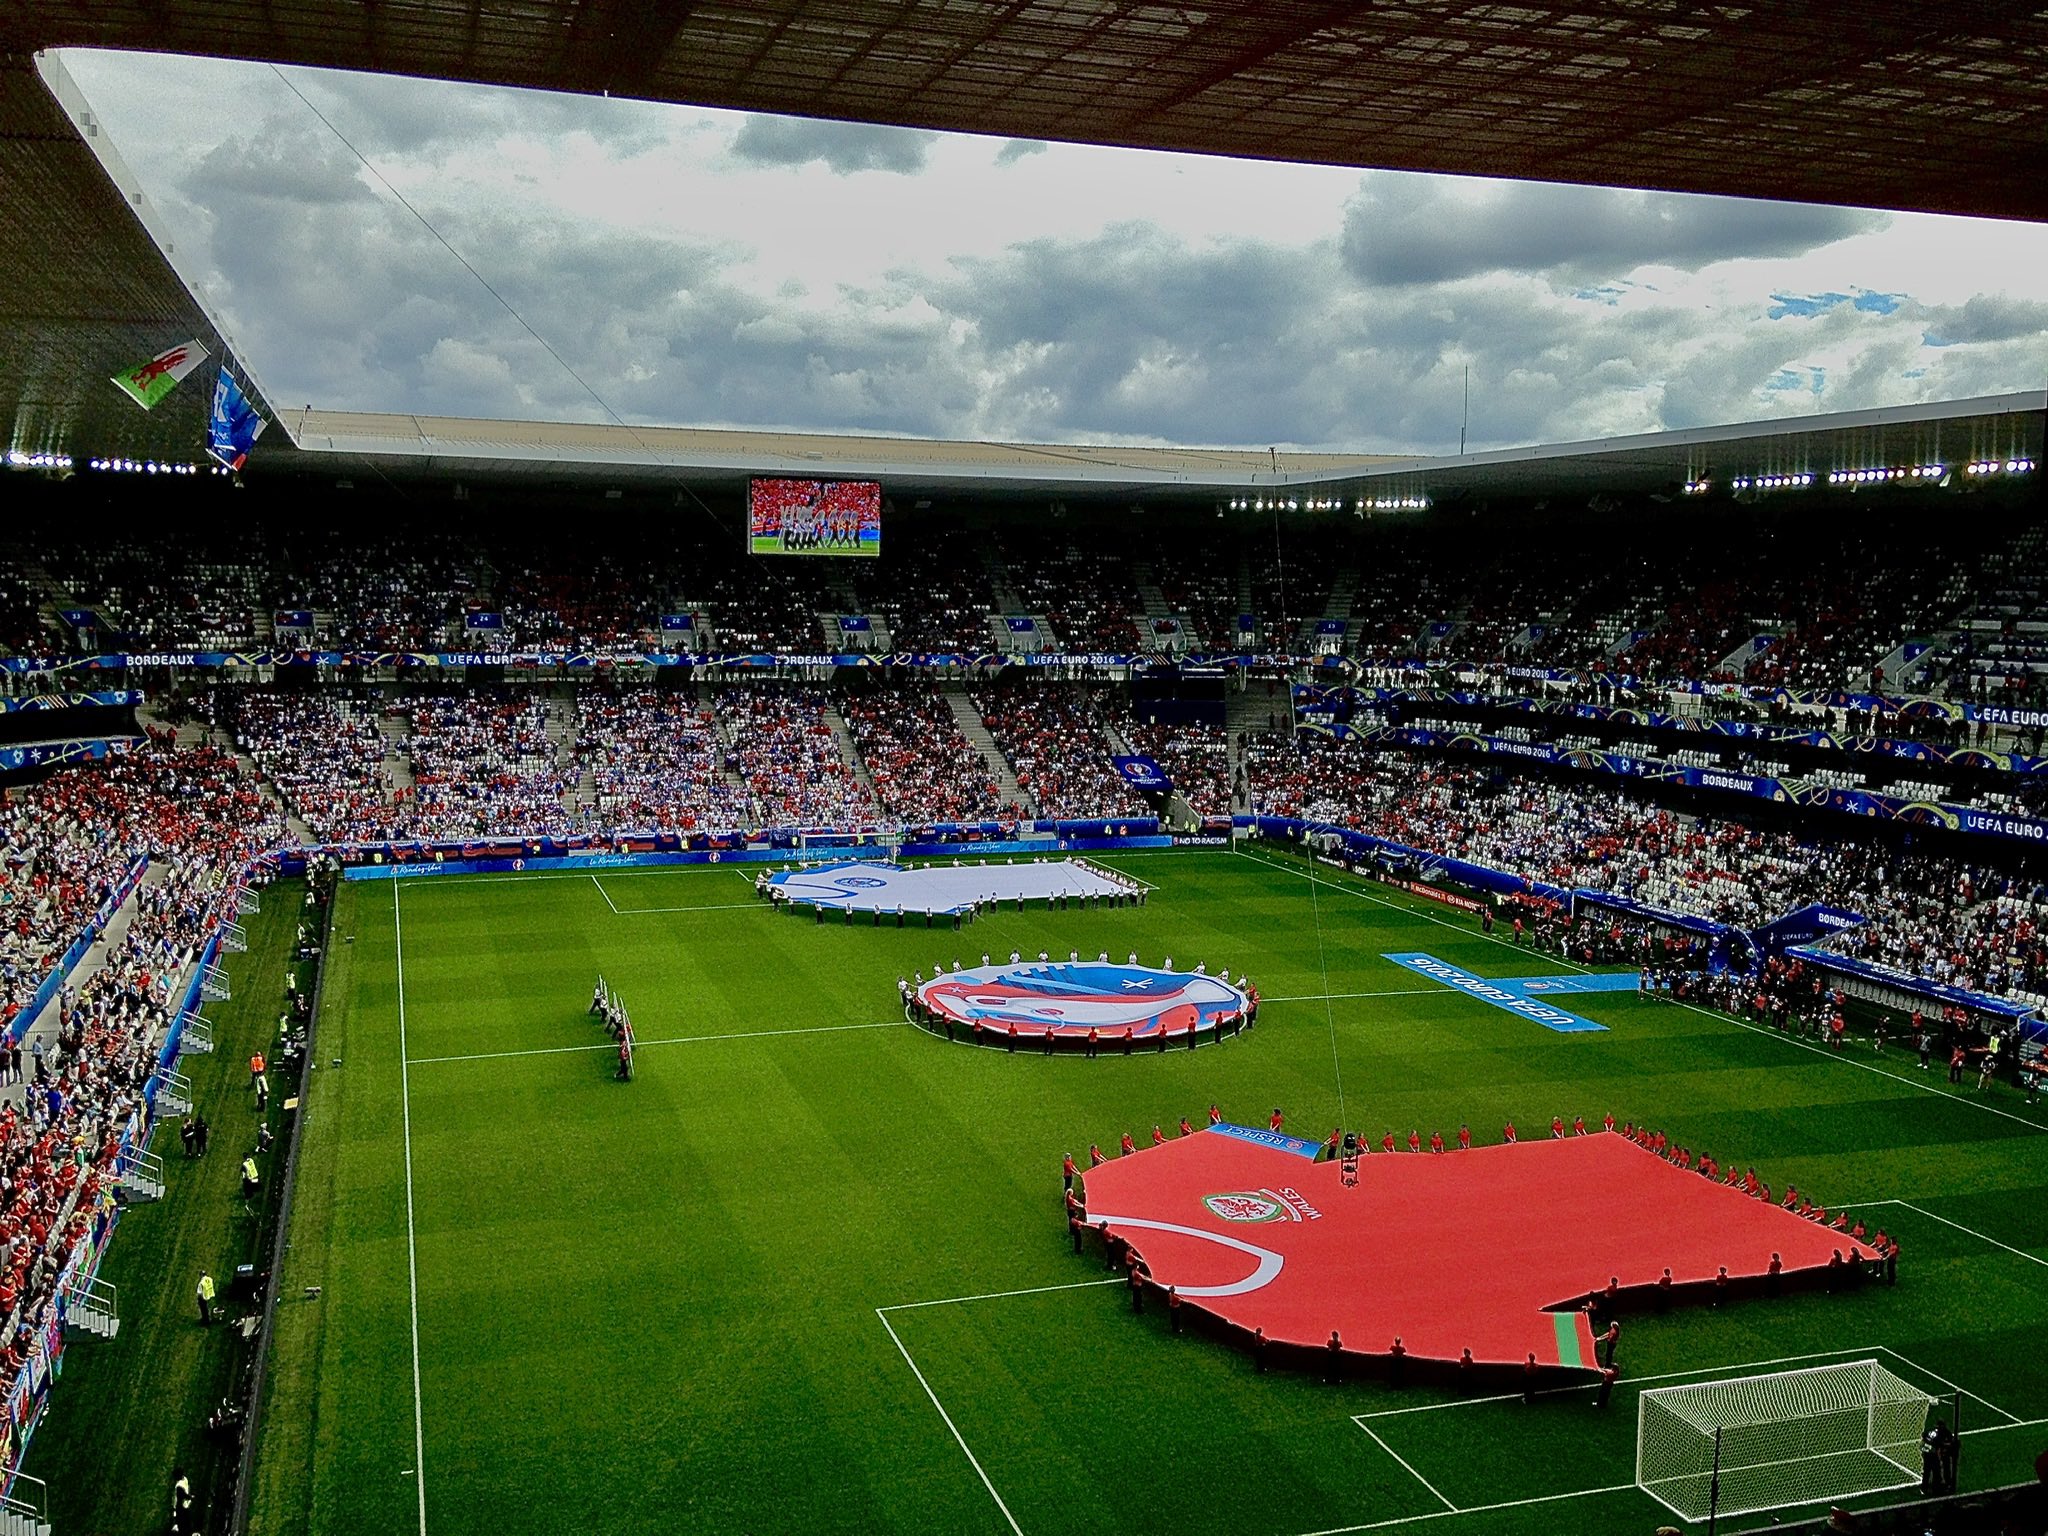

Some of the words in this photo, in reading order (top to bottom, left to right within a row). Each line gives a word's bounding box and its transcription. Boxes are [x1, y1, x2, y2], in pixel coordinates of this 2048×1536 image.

[126, 655, 195, 666] BORDEAUX
[448, 655, 482, 665] UEFA
[484, 655, 513, 665] EUR
[1032, 655, 1060, 665] UEFA
[1061, 655, 1089, 664] EURO
[1090, 655, 1115, 664] 2016
[1511, 667, 1531, 678] EURO
[1531, 668, 1550, 679] 2016
[2012, 710, 2048, 726] EURO
[1493, 741, 1513, 753] UEFA
[1513, 744, 1532, 756] EURO
[1532, 747, 1551, 759] 2016
[1702, 774, 1754, 792] BORDEAUX
[1967, 815, 2003, 833] UEFA
[2005, 821, 2044, 839] EURO
[1179, 837, 1191, 845] NO
[1191, 837, 1200, 845] TO
[1201, 837, 1227, 845] RACISM
[1415, 885, 1441, 899] McDonald's
[1406, 958, 1465, 978] 2016
[1451, 978, 1516, 1000] EURO
[1507, 1000, 1575, 1024] UEFA
[1223, 1126, 1284, 1145] RESPECT
[1279, 1187, 1323, 1220] WALES
